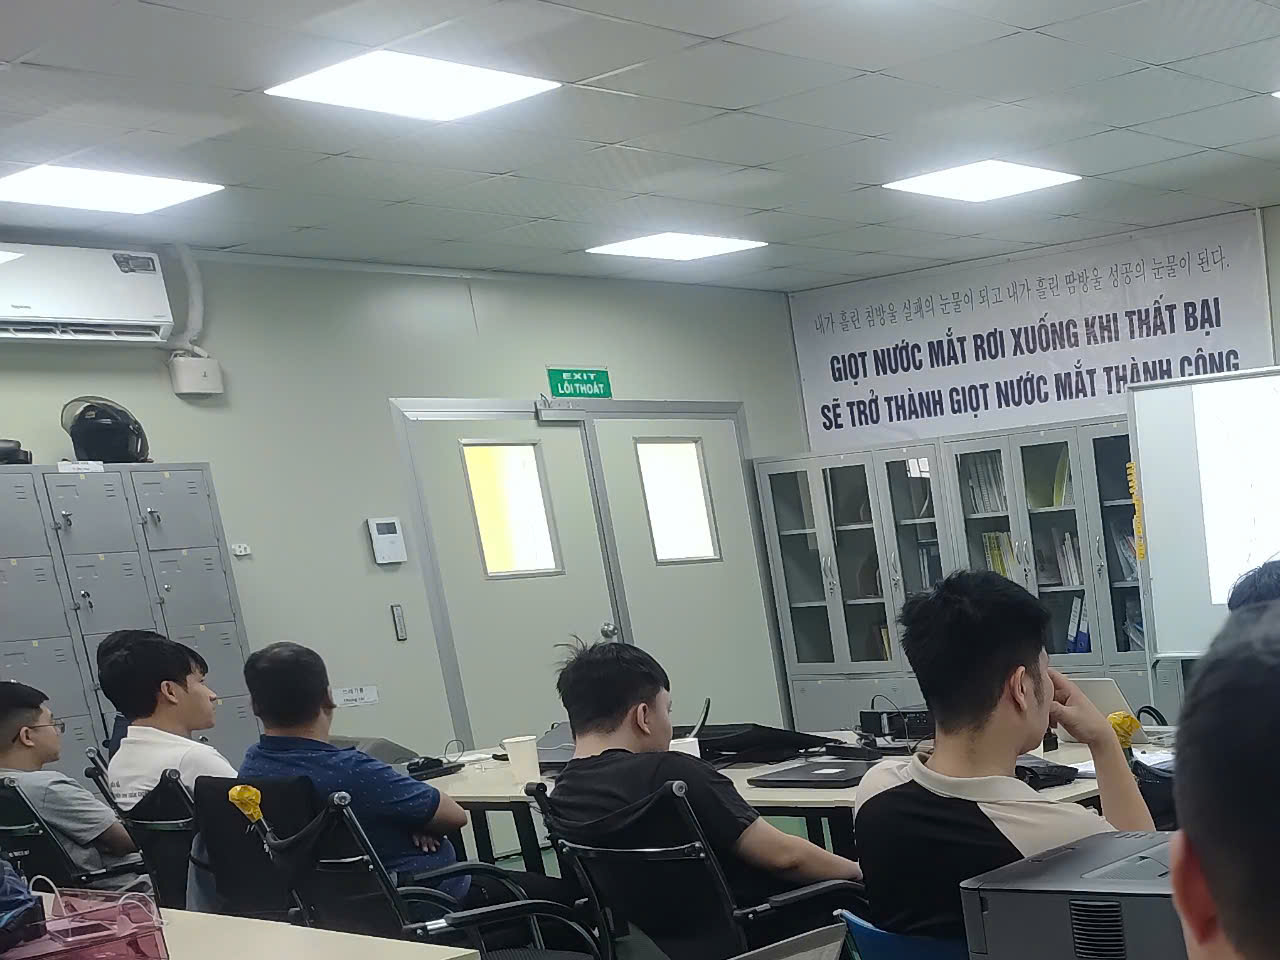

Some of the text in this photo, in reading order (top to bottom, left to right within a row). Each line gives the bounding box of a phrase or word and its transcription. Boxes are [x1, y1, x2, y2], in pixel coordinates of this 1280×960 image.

[814, 312, 836, 335] 내가
[839, 308, 861, 332] 흘린
[902, 295, 935, 321] 실패의
[939, 288, 974, 315] 눈물이
[979, 285, 1004, 310] 되고
[1007, 278, 1031, 304] 내가
[1035, 274, 1060, 299] 흘린
[1065, 267, 1103, 296] 땀방울
[1108, 258, 1146, 288] 성공의
[1151, 251, 1191, 280] 눈물이
[1197, 245, 1230, 273] 된다.
[562, 372, 597, 380] EXIT
[830, 294, 1222, 386] GIỌT NƯỚC MẮT RƠI XUỐNG KHI THẤT BẠI
[574, 380, 604, 394] THOÁT
[820, 347, 1240, 432] SẼ TRỞ THÀNH GIỌT NƯỚC MẮT THÀNH CÔNG
